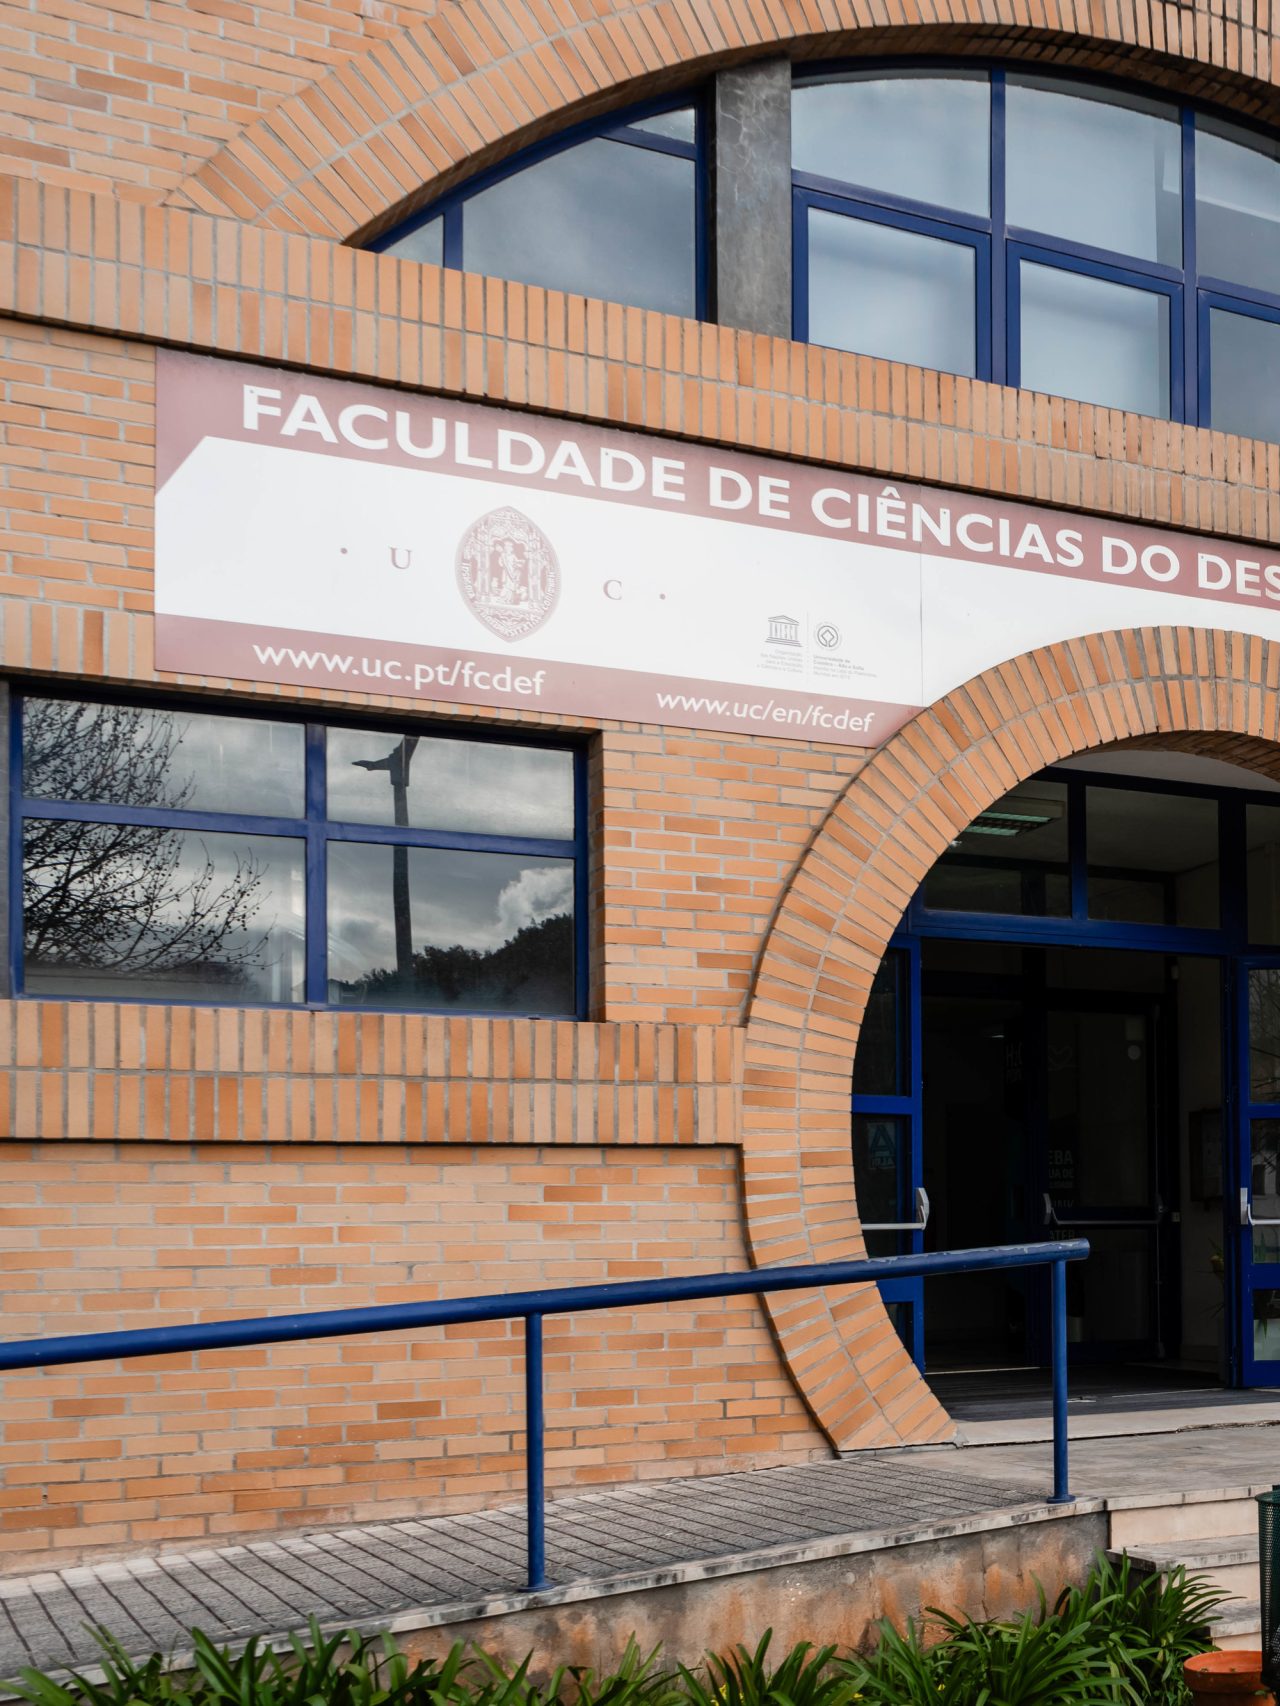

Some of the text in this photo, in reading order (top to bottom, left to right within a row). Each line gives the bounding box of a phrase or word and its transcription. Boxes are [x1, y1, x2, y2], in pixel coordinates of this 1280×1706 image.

[243, 384, 686, 502] FACULDADE
[709, 466, 791, 520] DE
[811, 486, 1085, 568] CIÊNCIAS
[1101, 535, 1180, 582] DO
[388, 545, 623, 601] U C
[252, 644, 547, 696] www.uc.pt/fcdef
[656, 692, 875, 733] www.uc/en/fcdef
[1048, 1149, 1074, 1165] EBA
